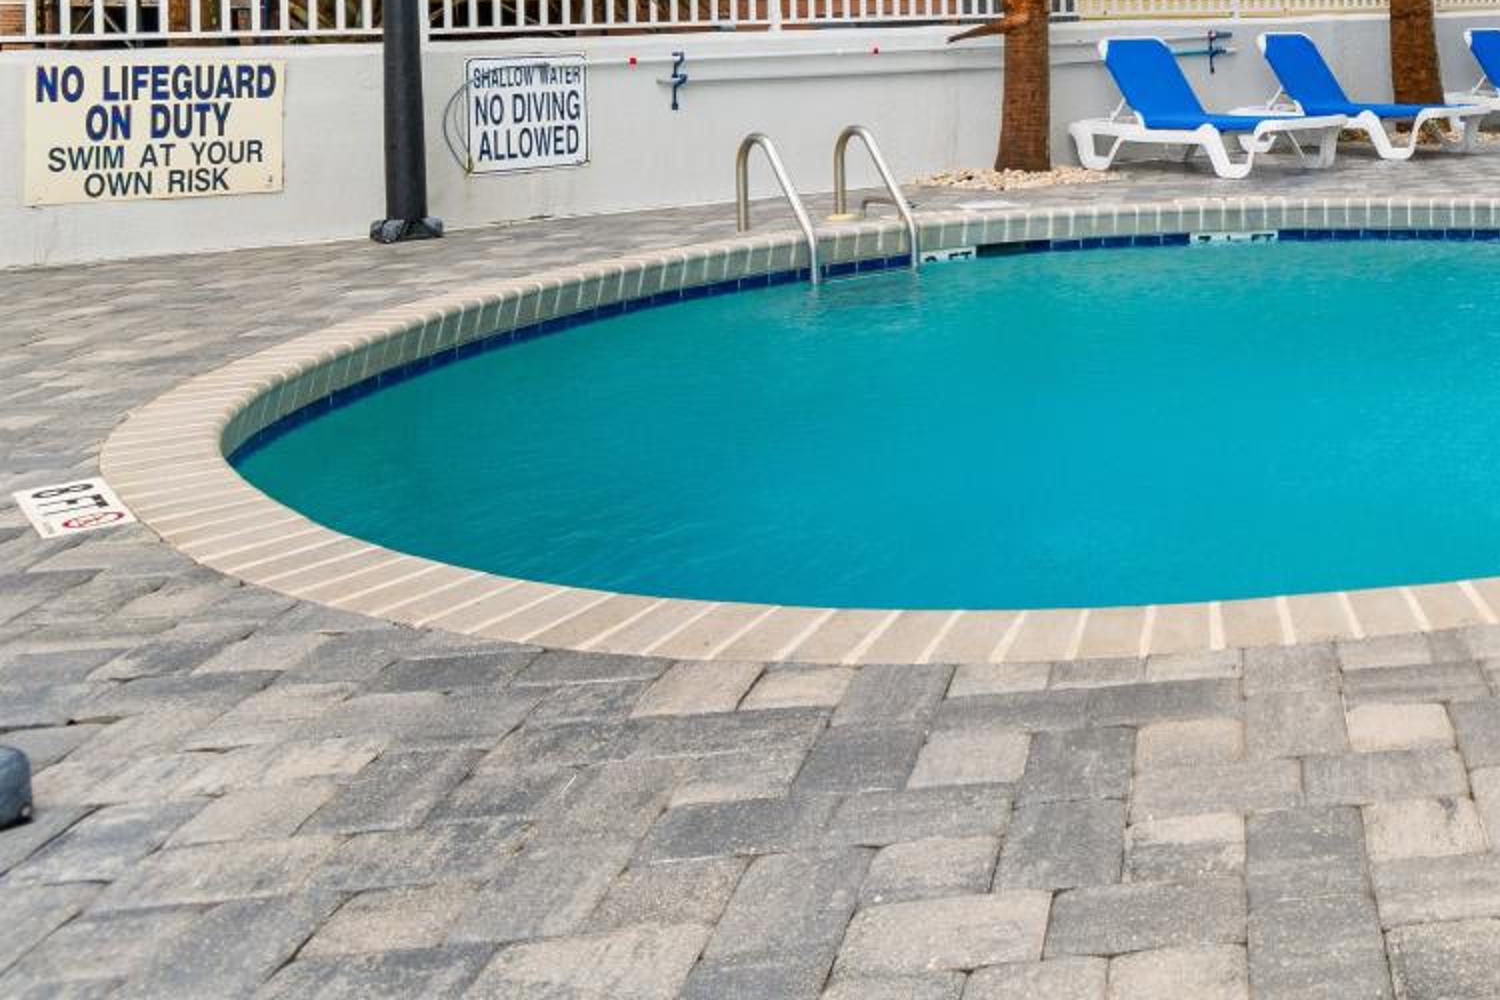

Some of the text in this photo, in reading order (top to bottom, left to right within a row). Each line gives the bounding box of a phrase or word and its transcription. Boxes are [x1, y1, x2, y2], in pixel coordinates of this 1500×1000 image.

[36, 64, 277, 102] NO LIFEGUARD
[473, 65, 581, 88] SHALLOW WATER
[85, 102, 232, 141] ON DUTY
[475, 89, 581, 126] NO DIVING
[48, 140, 263, 172] SWIM AT YOUR
[478, 125, 579, 162] ALLOWED
[85, 168, 230, 198] OWN RISK
[31, 483, 109, 517] 8 FT
